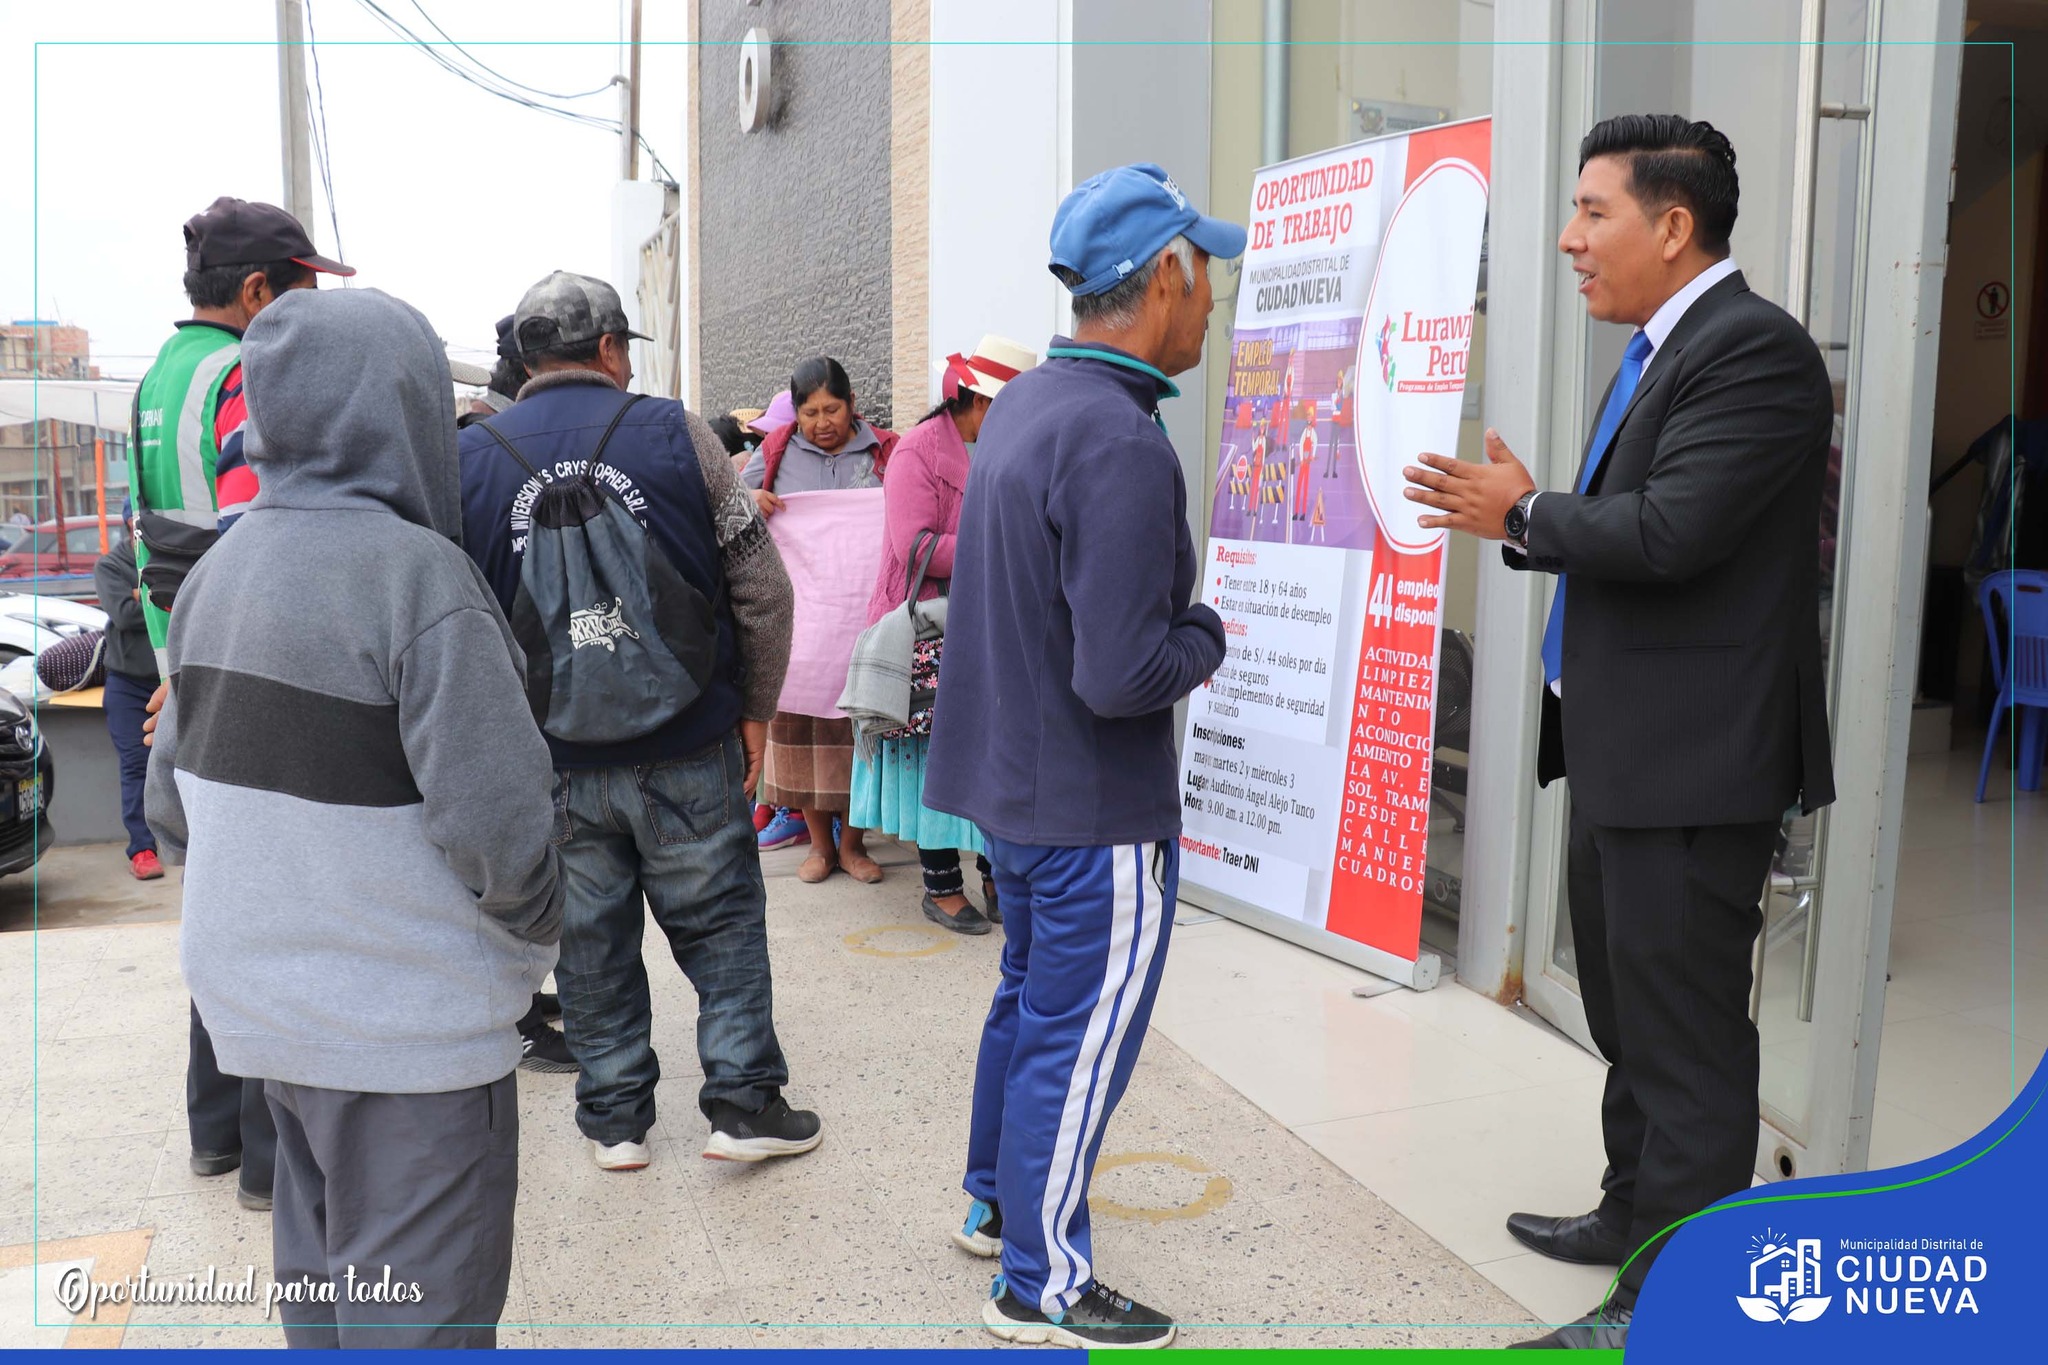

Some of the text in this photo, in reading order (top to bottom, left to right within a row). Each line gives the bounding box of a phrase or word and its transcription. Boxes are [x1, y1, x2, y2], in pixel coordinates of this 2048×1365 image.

[1257, 157, 1373, 211] OPORTUNIDAD
[1252, 203, 1352, 250] DE TRABAJO
[1249, 255, 1350, 284] MUNICIPALIDAD DISTRITAL DE
[1256, 276, 1341, 313] CIUDAD NUEVA
[1401, 305, 1473, 342] Lurawi
[1237, 338, 1273, 367] EMPLEO
[1426, 340, 1469, 376] Perú
[1224, 575, 1307, 599] Tener entre 18 y 64 años
[1368, 573, 1439, 629] 44 empleo
[1221, 595, 1238, 611] Estar
[1244, 599, 1279, 618] situación
[1280, 602, 1289, 619] de
[1291, 605, 1332, 626] desempleo
[1242, 645, 1252, 661] de
[1267, 650, 1277, 666] 44
[1278, 652, 1297, 669] soles
[1298, 658, 1312, 674] por
[1314, 657, 1327, 675] día
[1238, 669, 1269, 686] seguros
[1363, 665, 1431, 690] LIMPIEZ
[1207, 700, 1213, 714] y
[1210, 679, 1221, 694] Kit
[1227, 683, 1273, 706] implementos
[1275, 692, 1284, 709] de
[1286, 697, 1325, 716] seguridad
[1193, 723, 1245, 750] Inscripciones:
[1355, 723, 1431, 752] ACONDICIO
[1353, 742, 1412, 769] AMIENTO
[1212, 755, 1237, 774] martes
[1239, 761, 1245, 775] 2
[1245, 765, 1250, 779] y
[1251, 762, 1287, 788] miércoles
[1289, 773, 1295, 789] 3
[1350, 761, 1428, 792] LA AV. E
[1210, 777, 1244, 800] Auditorio
[1245, 783, 1267, 807] Ángel
[1268, 793, 1288, 814] Alejo
[1291, 799, 1315, 820] Tunco
[1348, 780, 1377, 802] SOL,
[1184, 791, 1282, 835] Hora: 9.00 am. a 12.00 pm.
[1345, 799, 1397, 827] DESDE
[1179, 833, 1259, 873] Importante: Traer DNI
[1338, 856, 1424, 895] CUADROS
